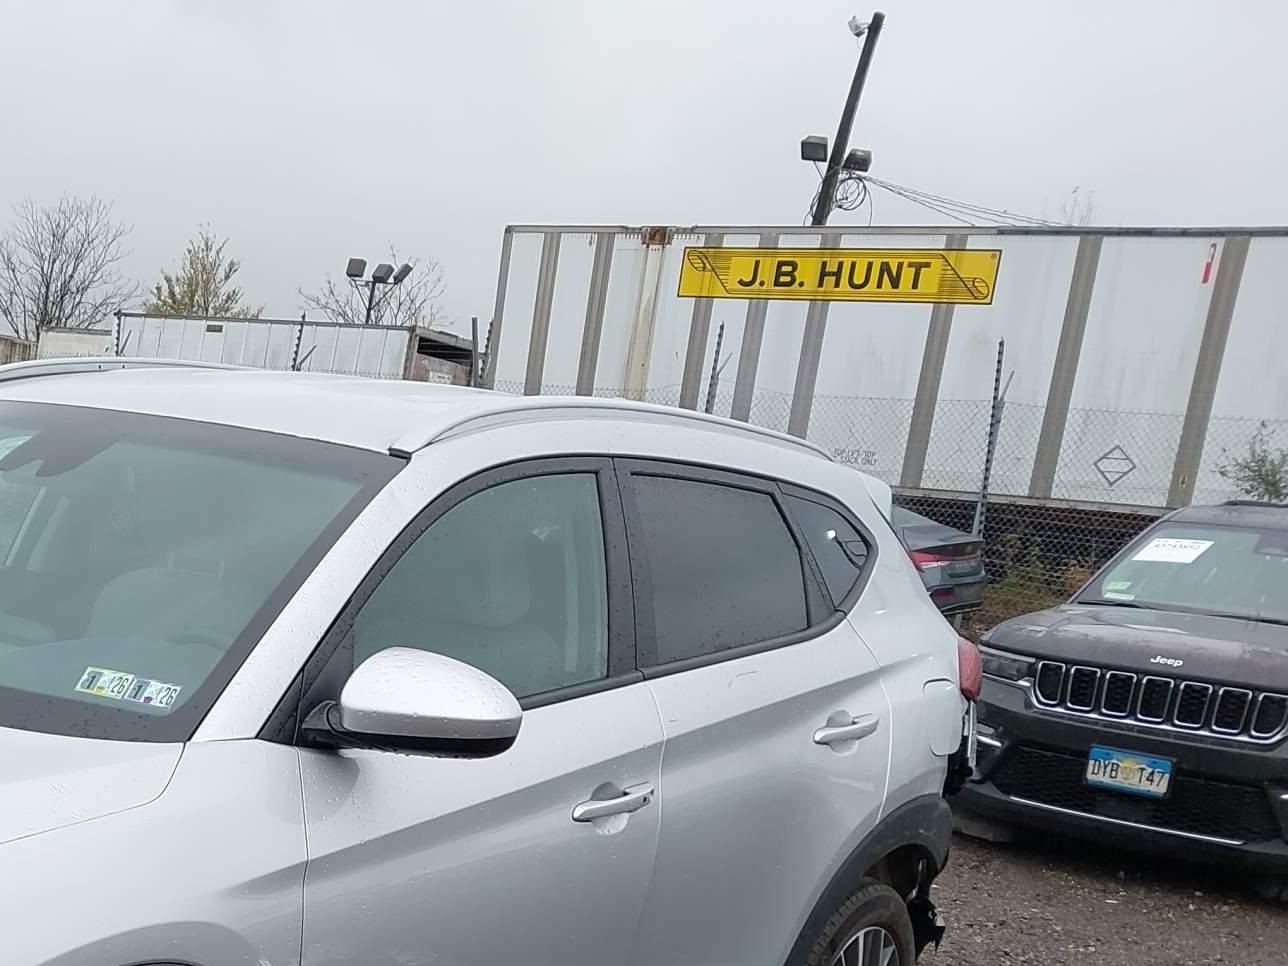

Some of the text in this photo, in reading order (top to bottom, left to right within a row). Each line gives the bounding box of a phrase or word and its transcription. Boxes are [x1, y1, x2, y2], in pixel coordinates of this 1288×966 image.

[736, 258, 932, 291] J.B. HUNT
[1149, 655, 1184, 668] Jeep
[1090, 759, 1166, 787] DYB T47
